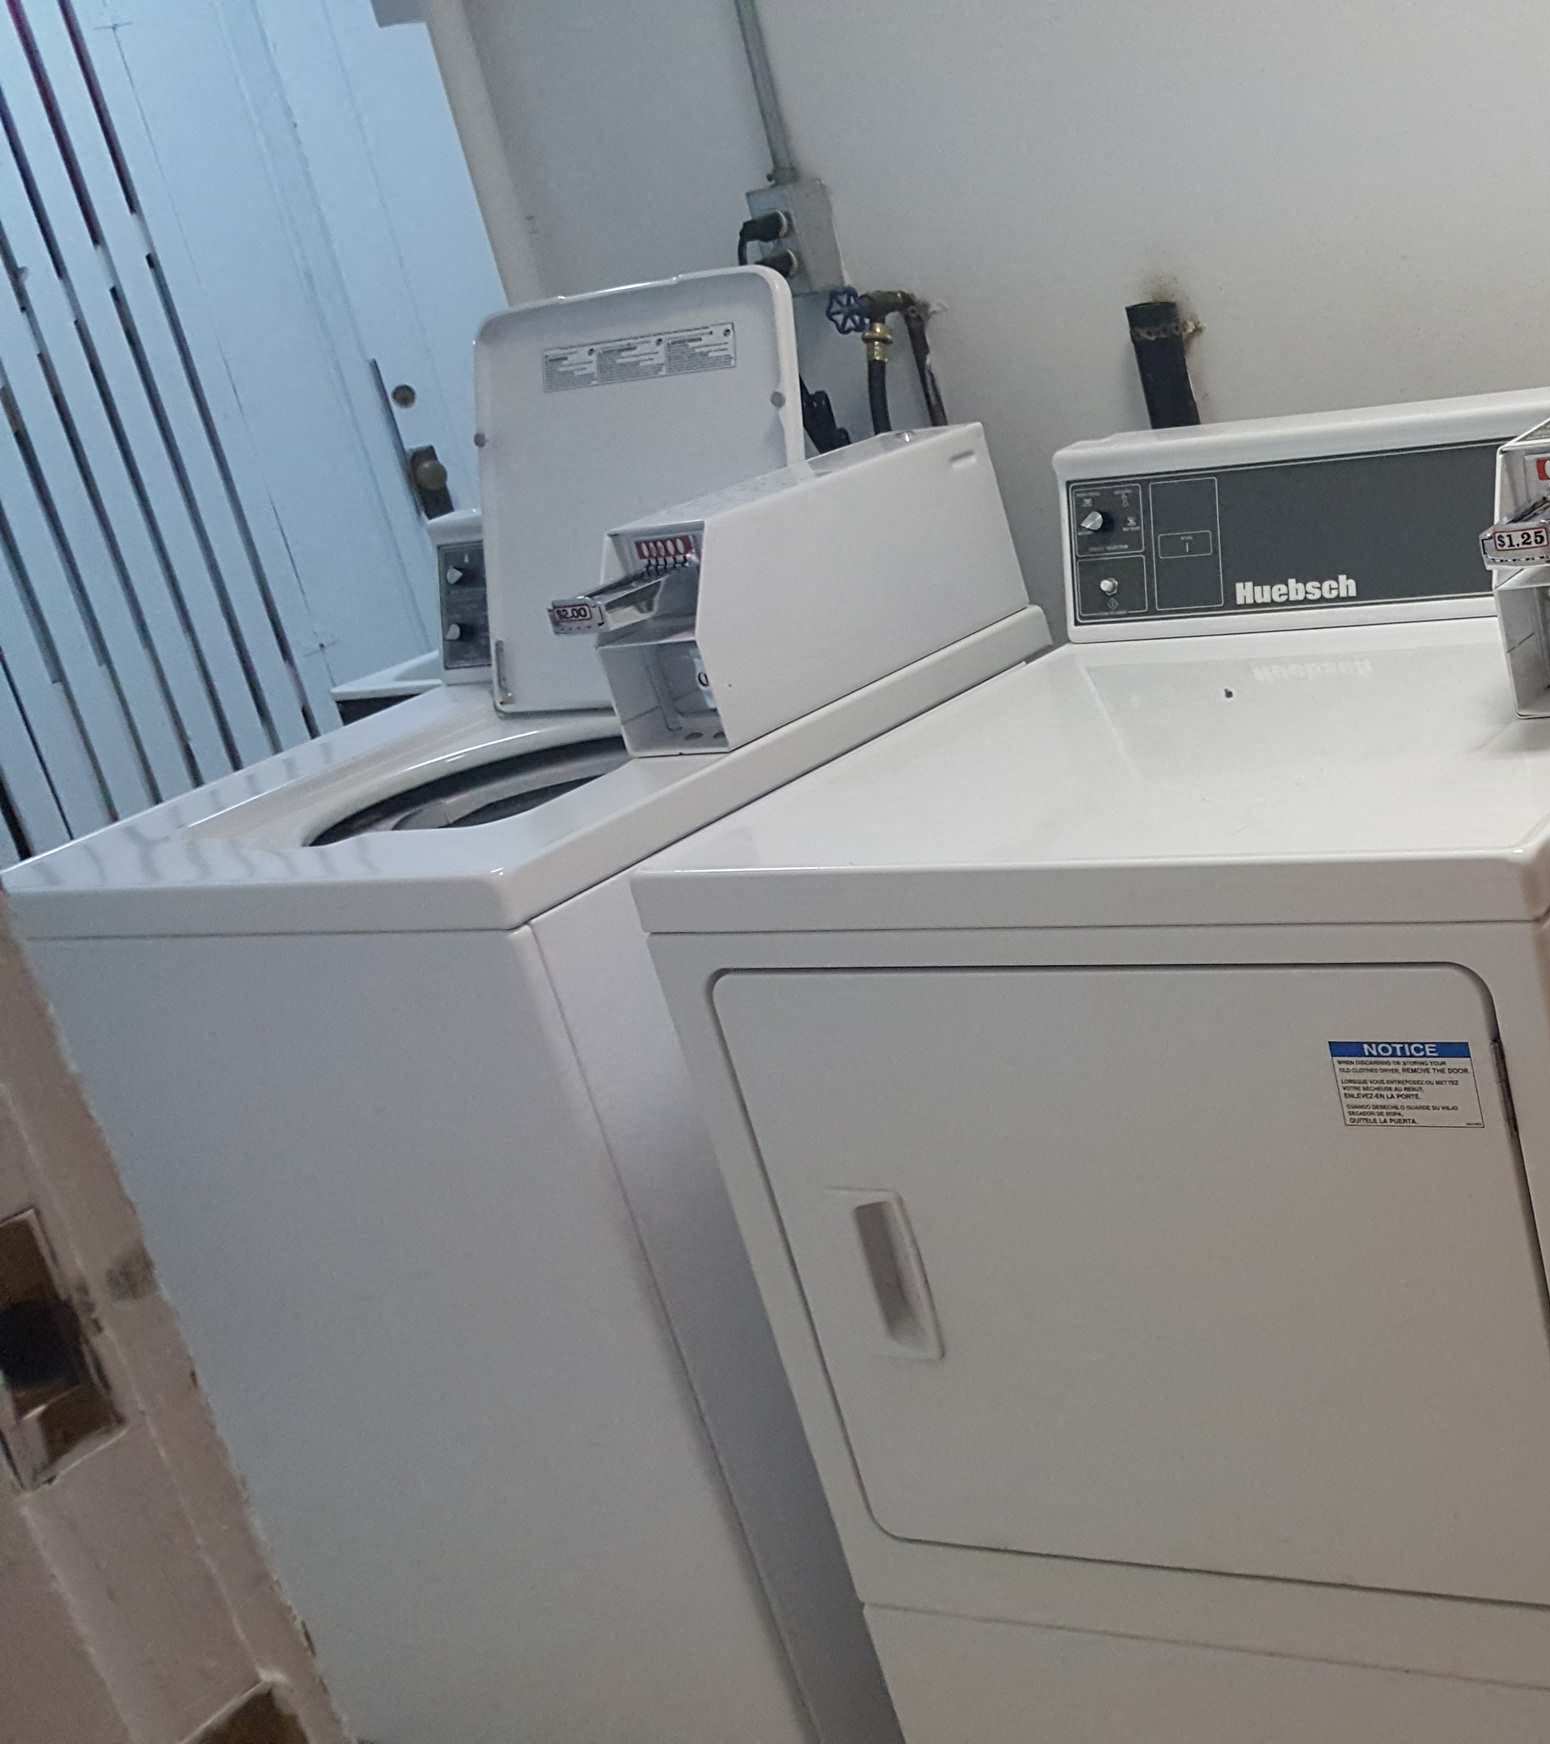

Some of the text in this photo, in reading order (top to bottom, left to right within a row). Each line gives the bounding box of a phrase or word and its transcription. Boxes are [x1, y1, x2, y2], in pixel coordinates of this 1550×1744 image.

[1497, 530, 1545, 548] $1.25
[1235, 574, 1357, 605] Huebsch
[1362, 1043, 1439, 1057] NOTICE
